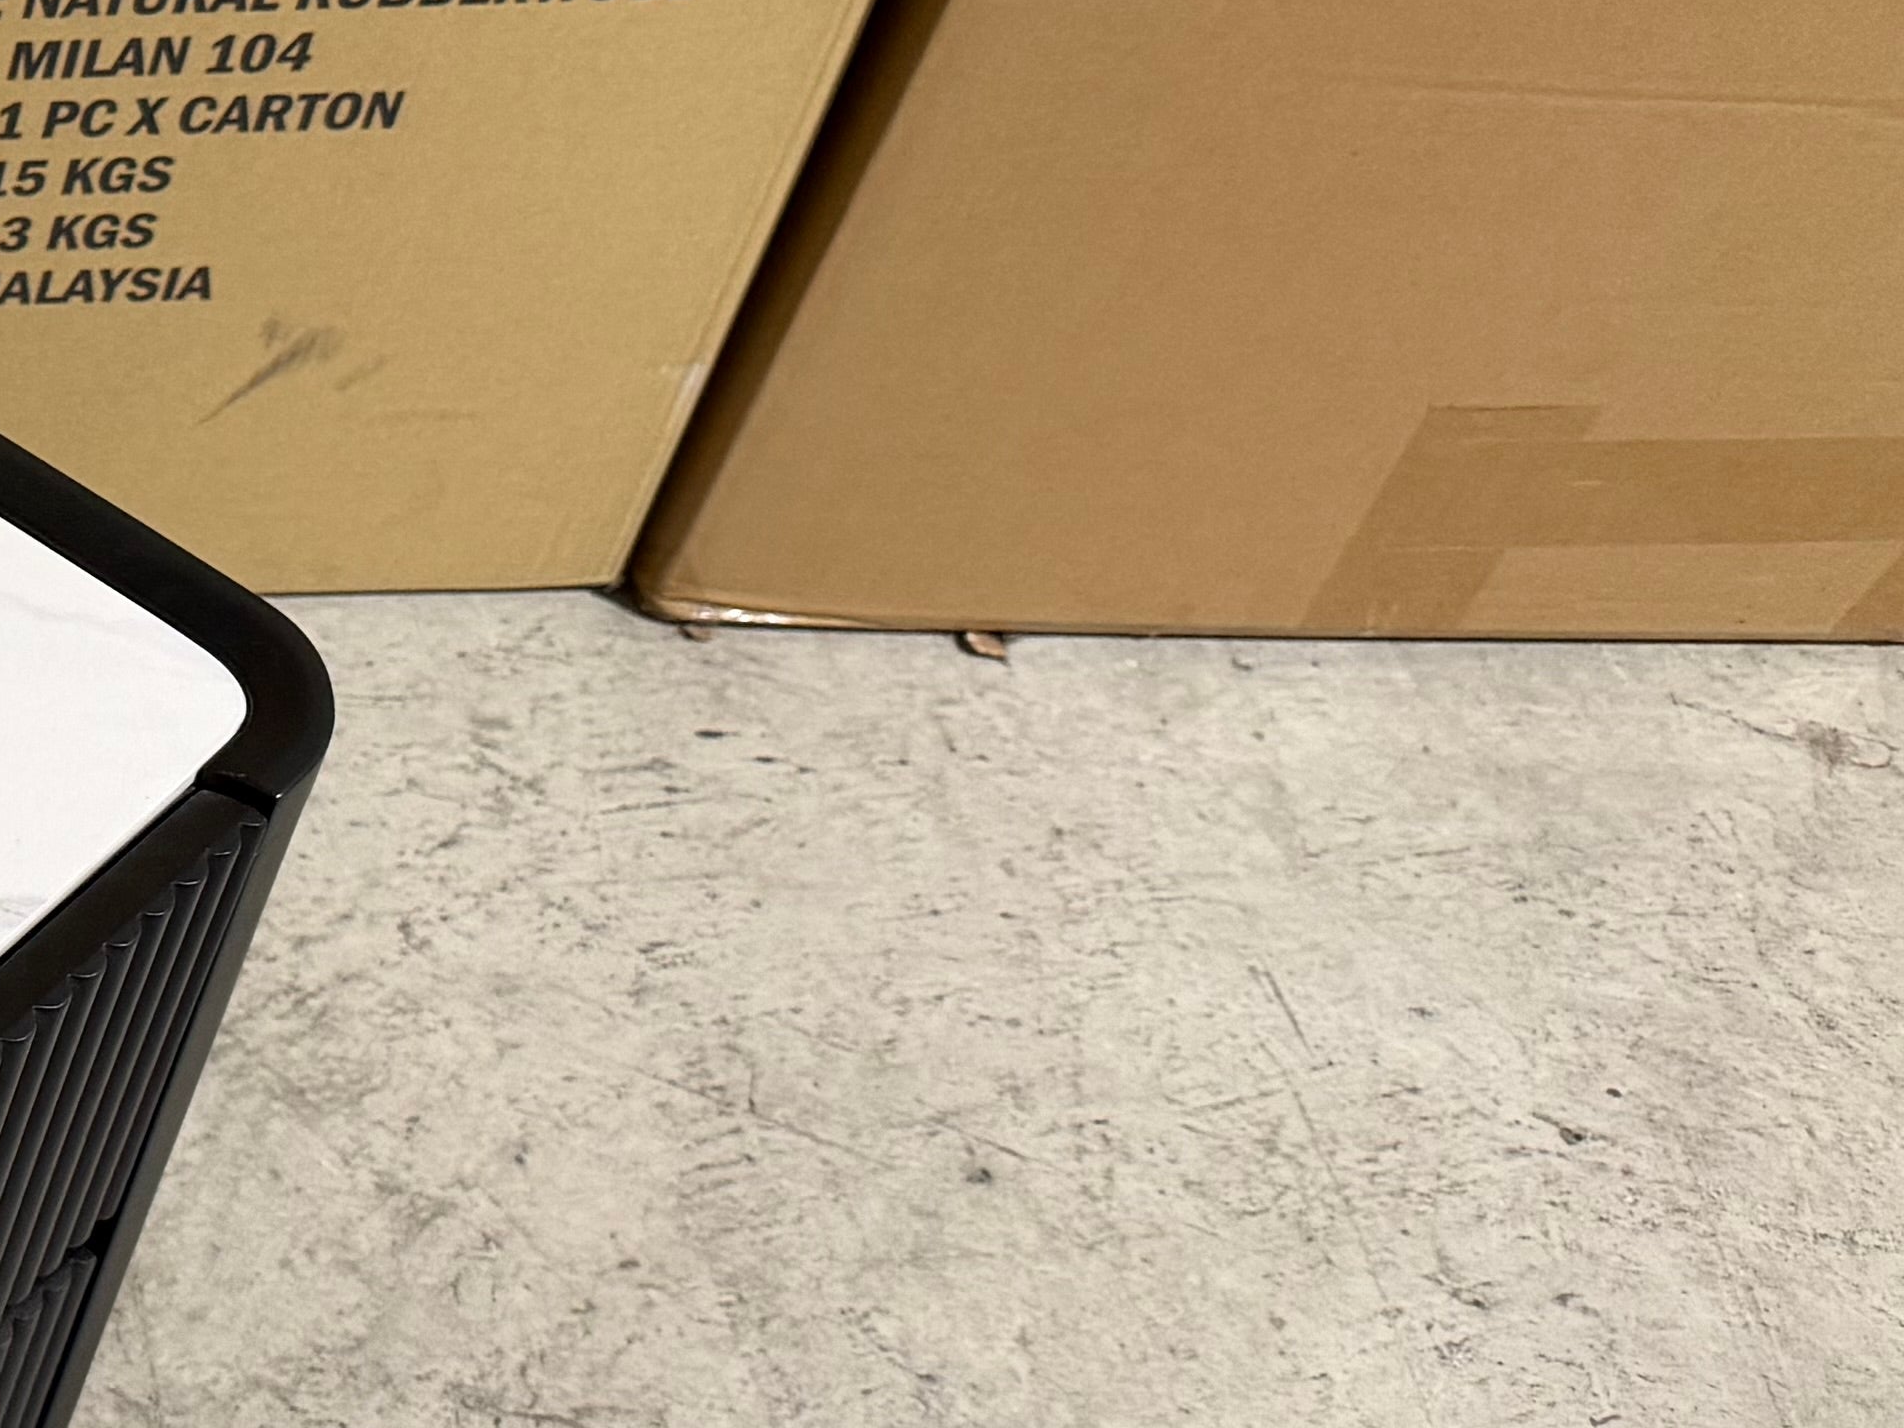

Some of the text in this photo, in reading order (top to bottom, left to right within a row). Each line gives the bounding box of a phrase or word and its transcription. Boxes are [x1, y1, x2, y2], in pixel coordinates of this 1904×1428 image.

[6, 35, 193, 81] MILAN
[205, 31, 315, 75] 104
[41, 98, 118, 139] PC
[124, 96, 170, 137] X
[178, 90, 406, 135] CARTON
[60, 155, 175, 196] KGS
[45, 212, 158, 251] KGS
